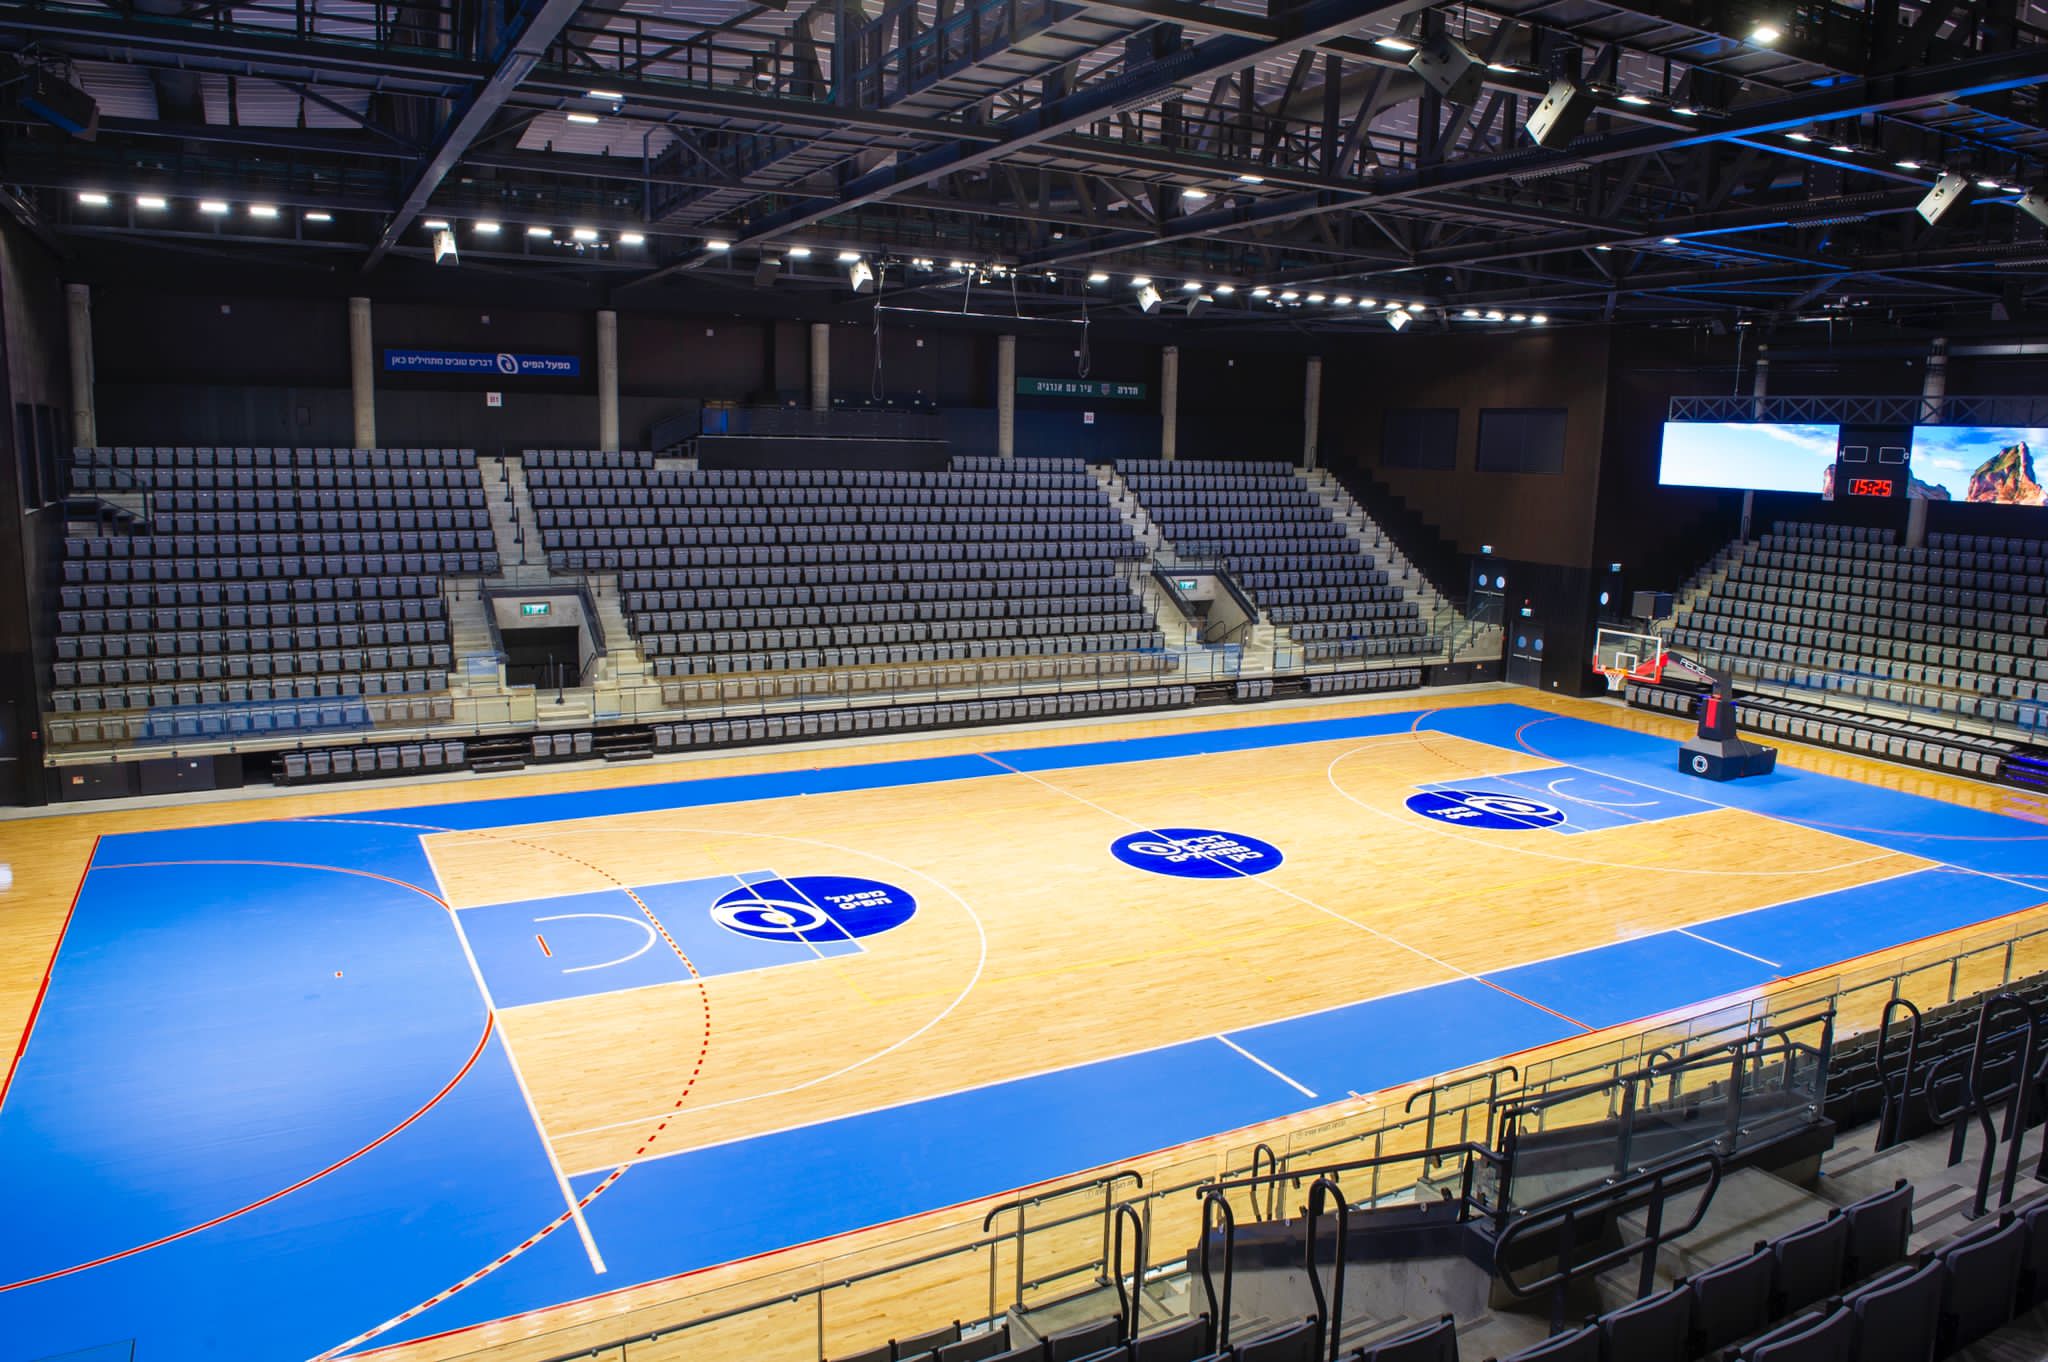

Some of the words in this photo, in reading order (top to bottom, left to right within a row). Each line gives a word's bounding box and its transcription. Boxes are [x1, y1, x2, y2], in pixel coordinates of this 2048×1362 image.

[391, 355, 407, 366] כאן
[408, 355, 444, 365] מתחילים
[445, 357, 468, 366] טובים
[469, 358, 493, 367] דברים
[522, 360, 544, 368] הפיס
[545, 360, 571, 370] מפעל
[1036, 382, 1062, 392] אנרגיה
[1080, 384, 1092, 392] עיר
[1118, 386, 1138, 396] חדרה
[1854, 479, 1892, 497] 15:25
[824, 890, 886, 903] מפעל
[838, 898, 893, 910] הפיס
